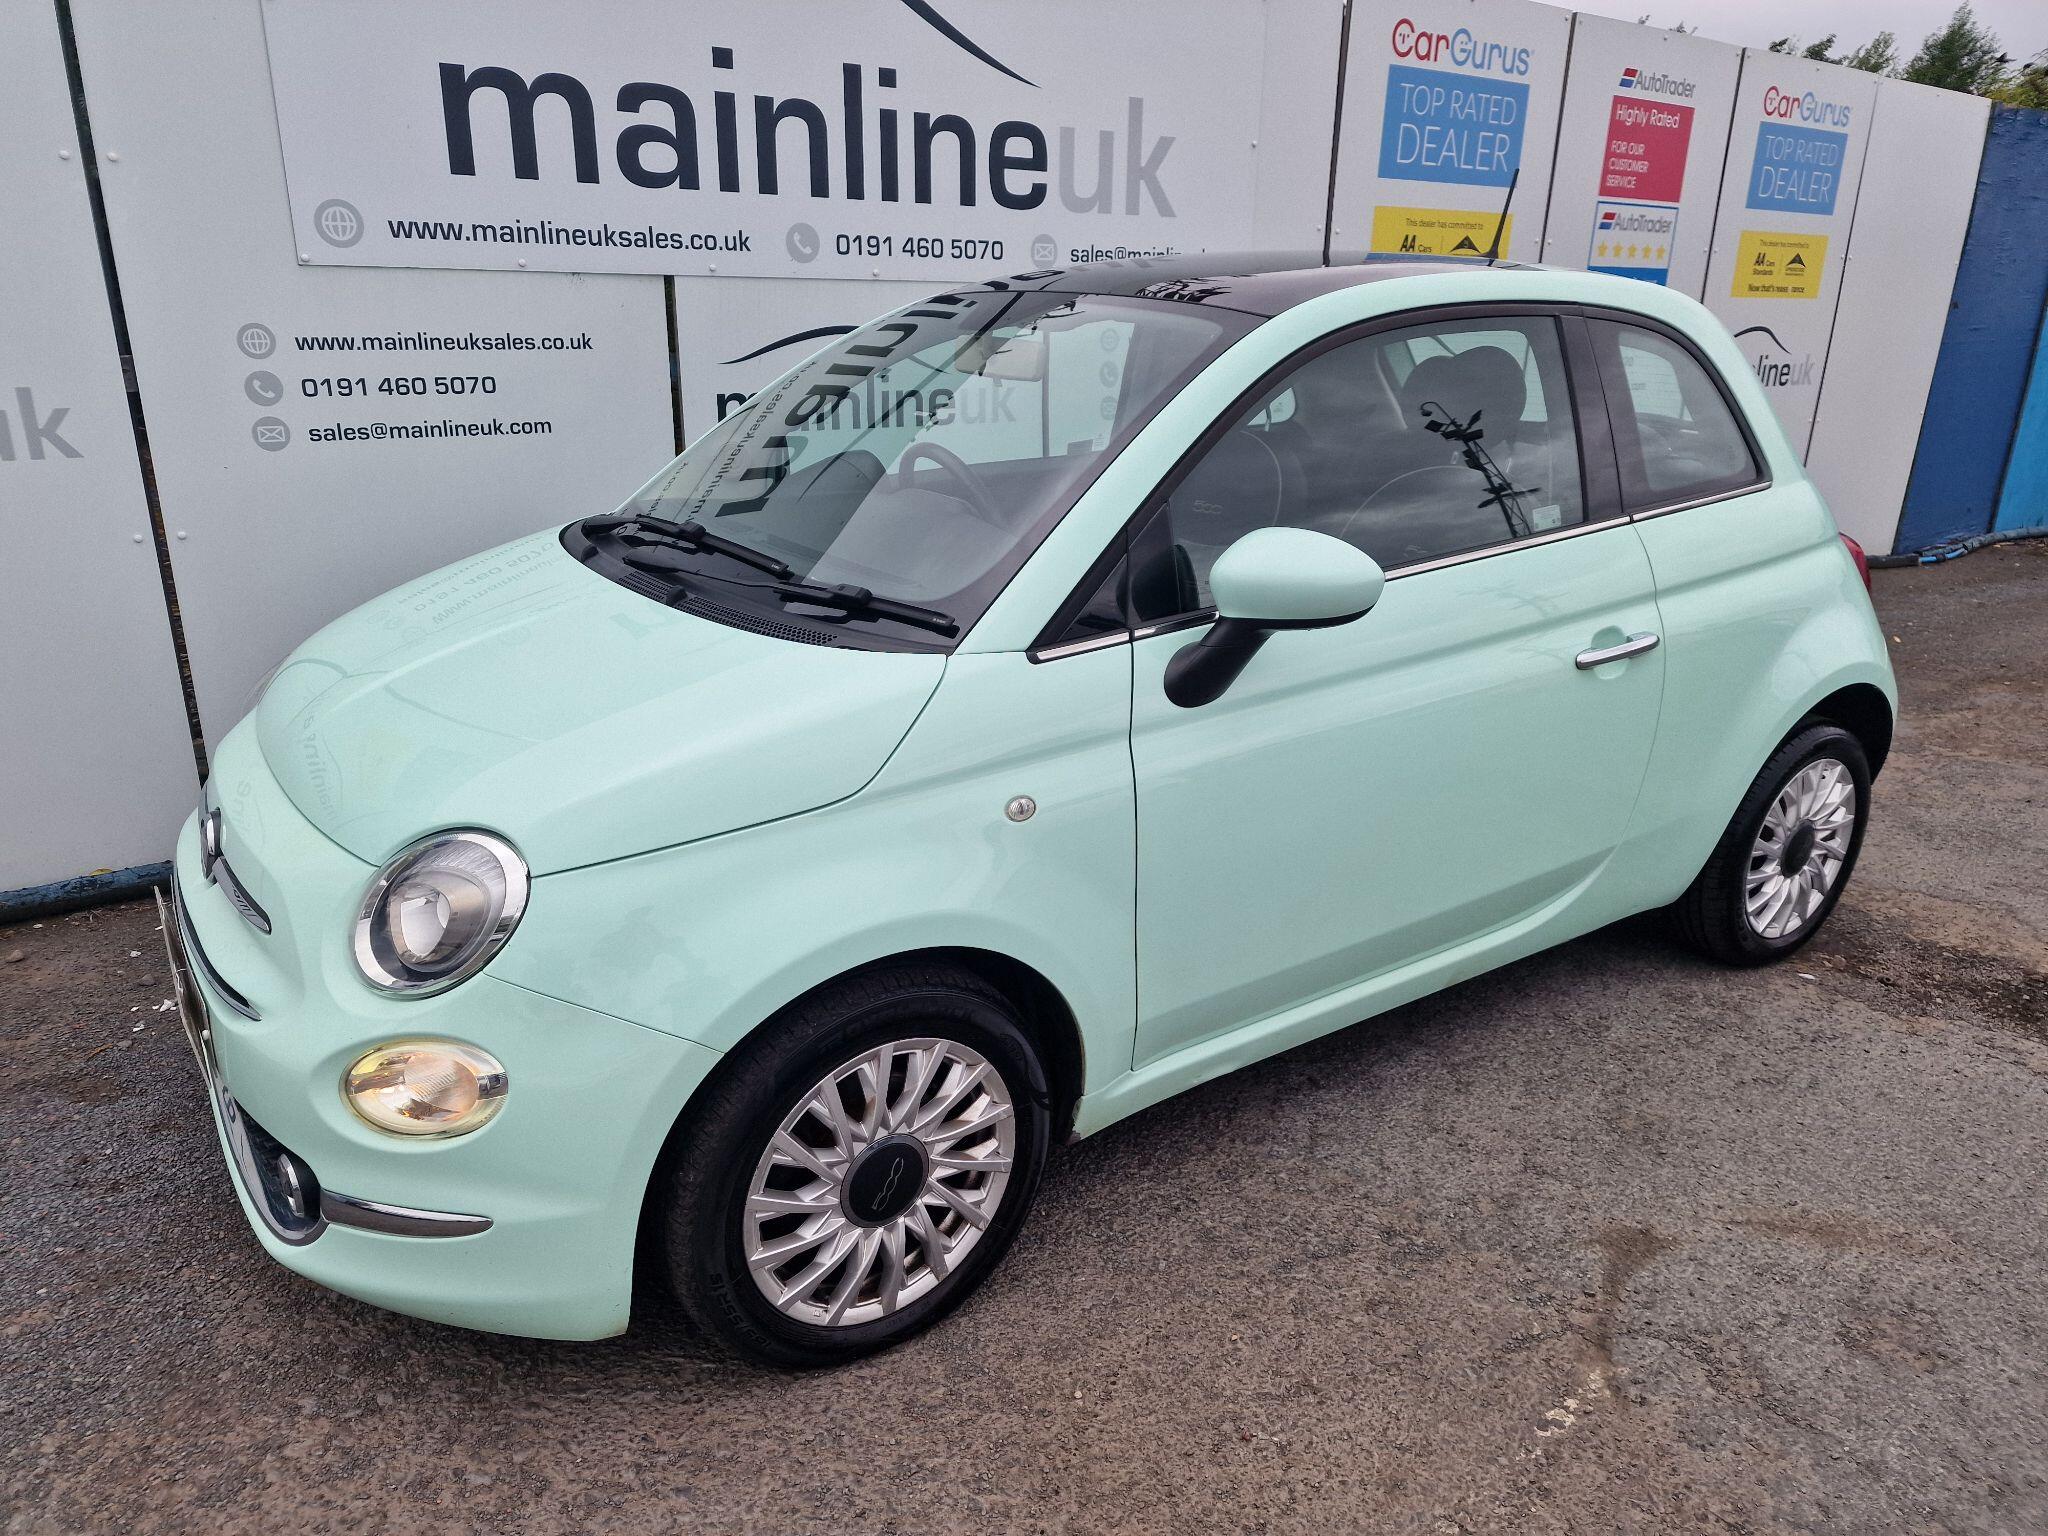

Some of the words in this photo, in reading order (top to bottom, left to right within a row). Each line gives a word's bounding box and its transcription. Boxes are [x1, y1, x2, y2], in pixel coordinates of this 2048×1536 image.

[1392, 18, 1530, 76] CarGurus
[1634, 71, 1696, 98] AutoTrader
[1400, 83, 1445, 117] TOP
[1450, 90, 1517, 125] RATED
[1616, 104, 1648, 127] Highly
[1649, 109, 1680, 128] Rated
[1763, 86, 1850, 127] CarGurus
[1396, 123, 1509, 172] DEALER
[1611, 140, 1627, 153] FOR
[1628, 142, 1645, 155] OUR
[1765, 135, 1794, 160] TOP
[1795, 140, 1839, 166] RATED
[1608, 157, 1649, 173] CUSTOMER
[1758, 166, 1831, 202] DEALER
[387, 219, 752, 253] www.mainlineuksales.co.uk
[1613, 213, 1672, 233] AutoTrader
[836, 233, 893, 257] 0191
[902, 237, 944, 259] 460
[950, 238, 1004, 261] 5070
[1400, 234, 1416, 252] AA
[295, 332, 594, 351] www.mainlineuksales.co.uk
[301, 377, 368, 397] 0191
[378, 376, 427, 396] 460
[434, 375, 497, 395] 5070
[308, 418, 552, 442] sales@mainlineuk.com
